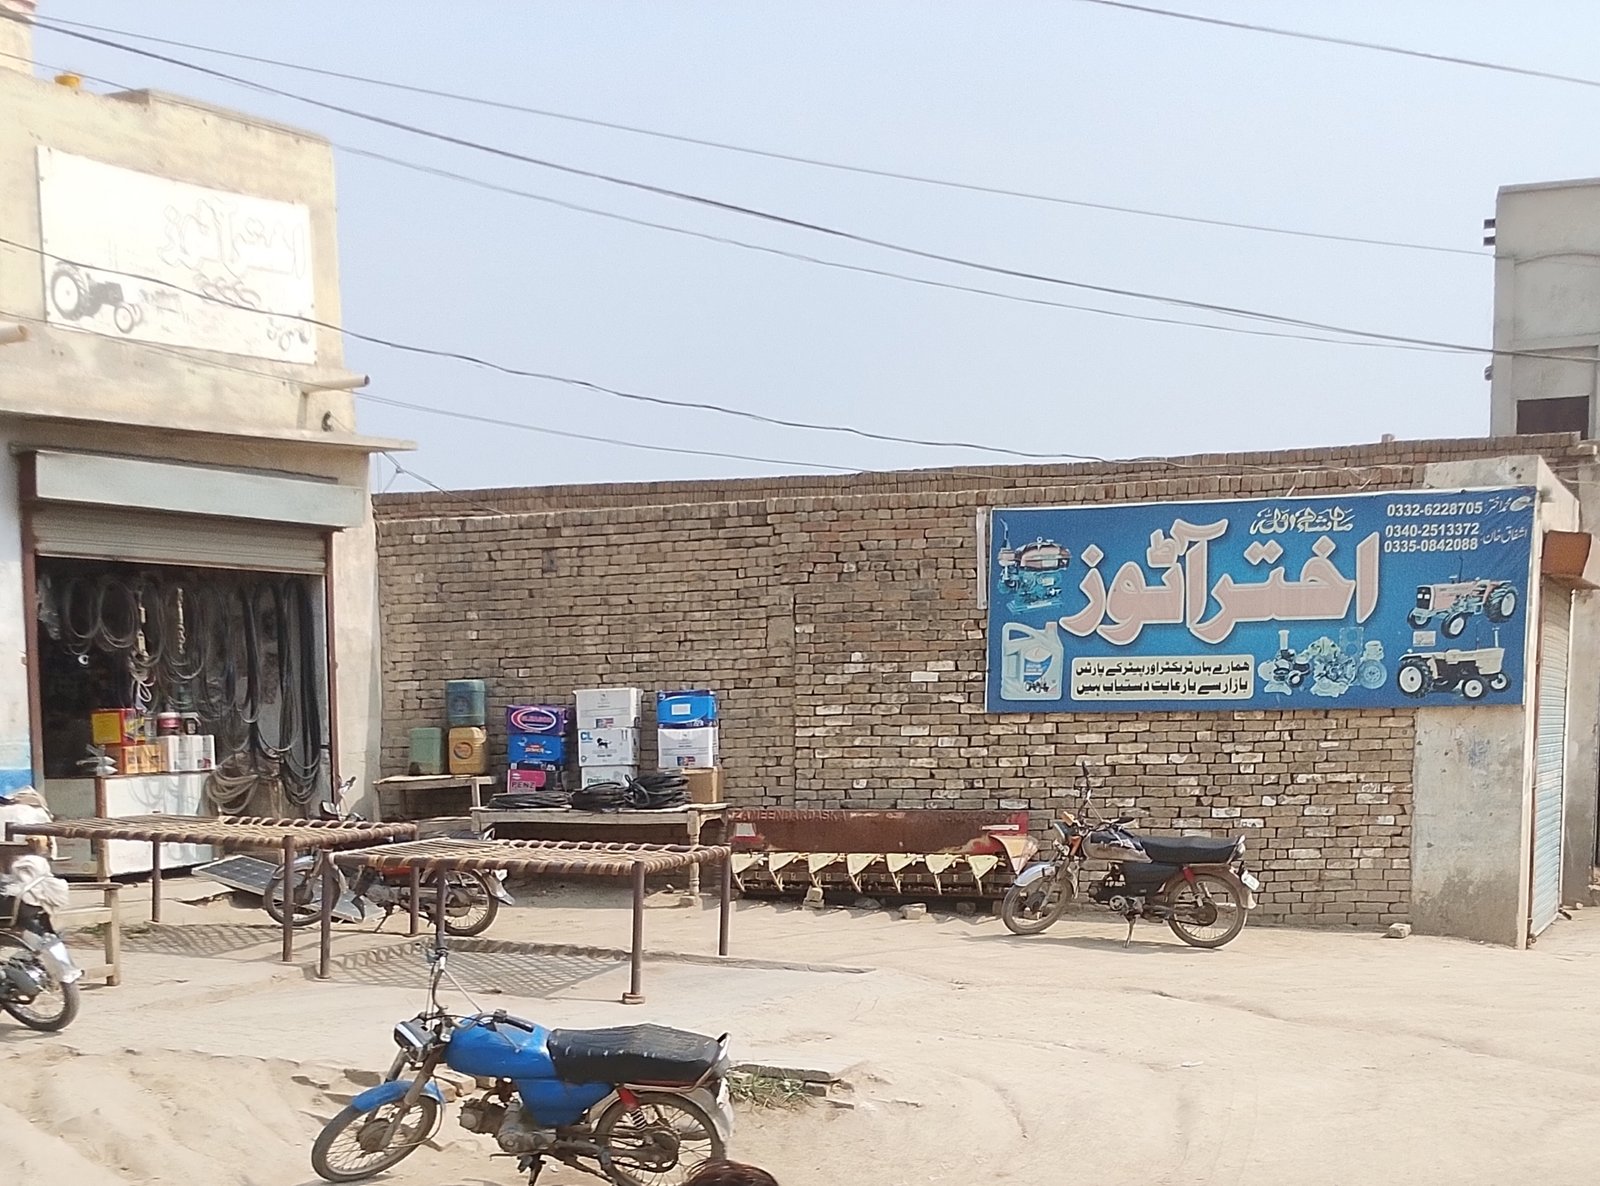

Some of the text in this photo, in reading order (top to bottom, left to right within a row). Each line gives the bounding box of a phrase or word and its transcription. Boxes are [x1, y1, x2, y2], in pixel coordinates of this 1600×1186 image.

[1387, 501, 1483, 517] 0332-6228705
[1385, 522, 1480, 538] 0340-2513372
[1384, 537, 1478, 553] 0335-0842088
[1059, 518, 1380, 646] اختر آٹوز
